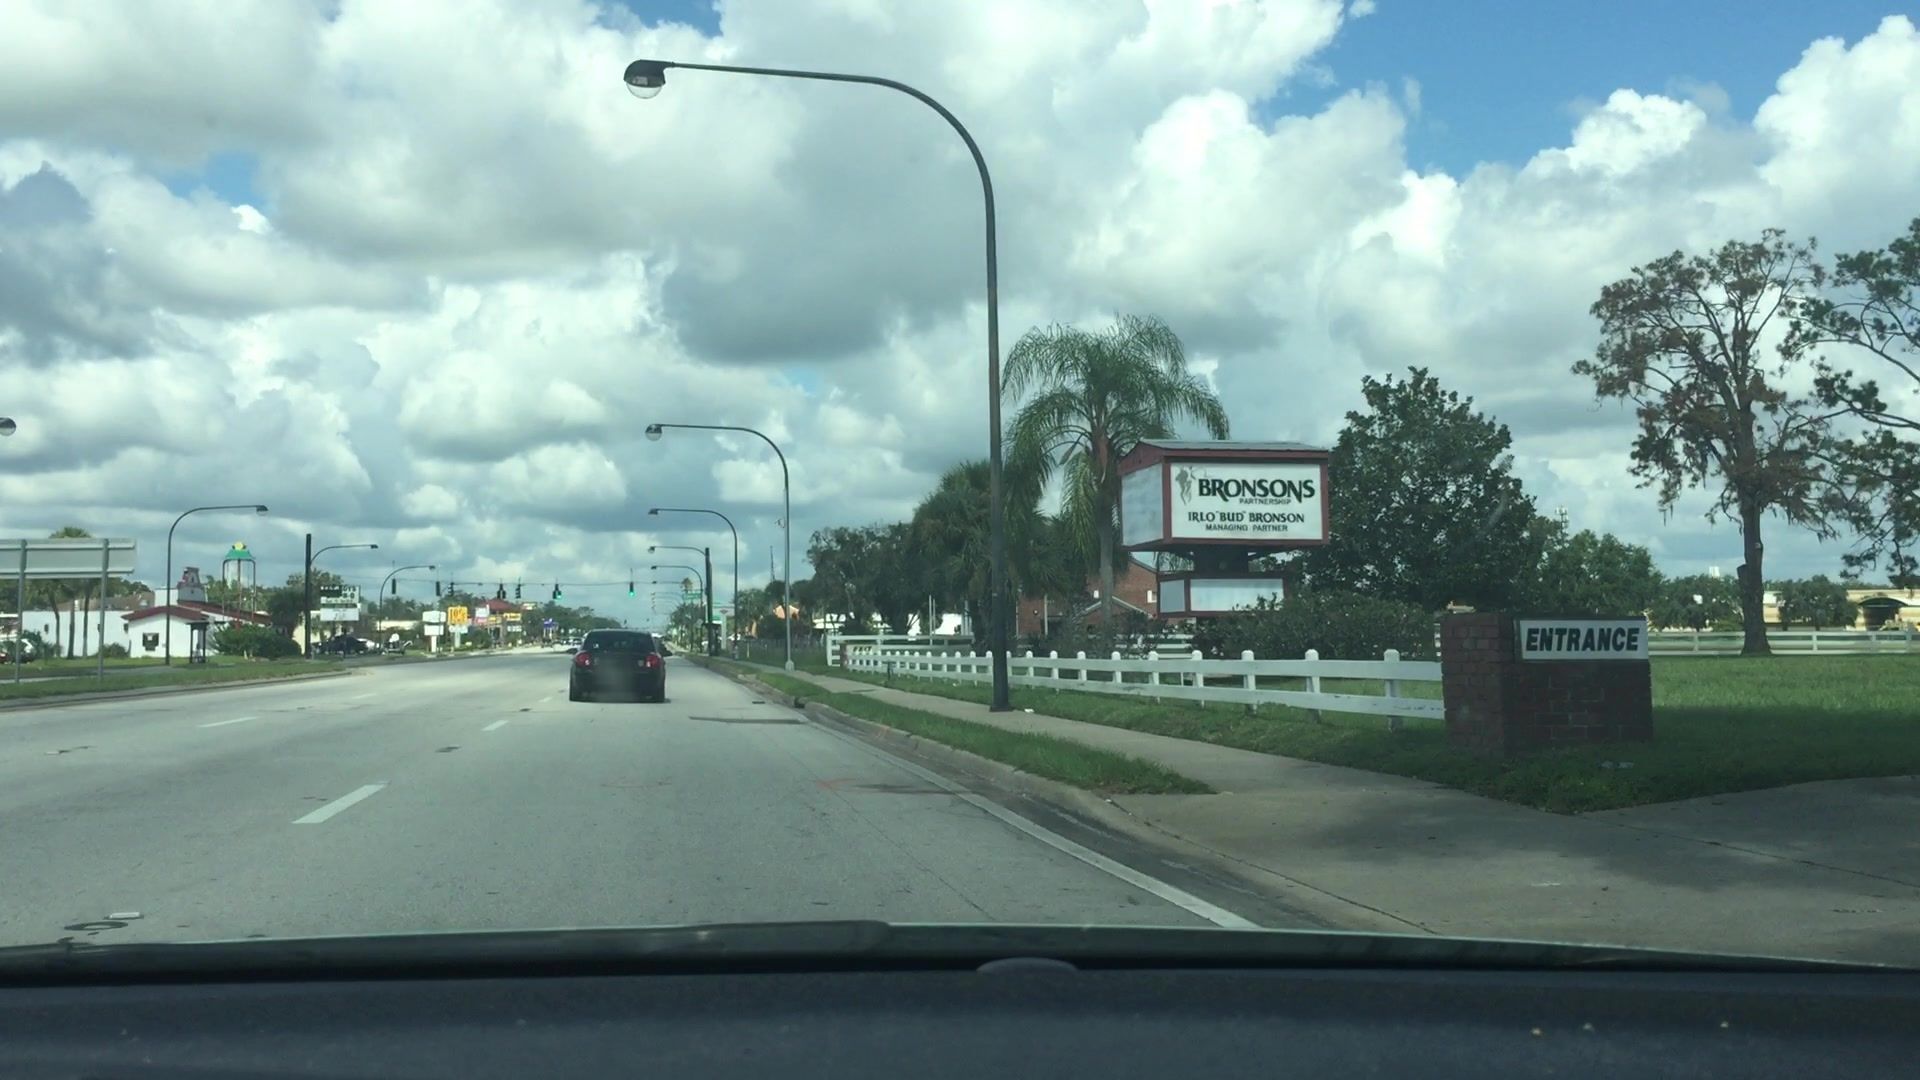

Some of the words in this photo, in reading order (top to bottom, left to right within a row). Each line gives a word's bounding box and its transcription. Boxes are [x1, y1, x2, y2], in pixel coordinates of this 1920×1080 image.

[1198, 478, 1316, 503] BRONSONS
[1239, 497, 1292, 505] PARTNERSHIP
[1188, 511, 1215, 523] IRLO
[1249, 512, 1305, 523] BRONSON
[1205, 523, 1249, 531] MANAGING
[1252, 524, 1288, 532] PARTNER
[1525, 627, 1641, 652] ENTRANCE
